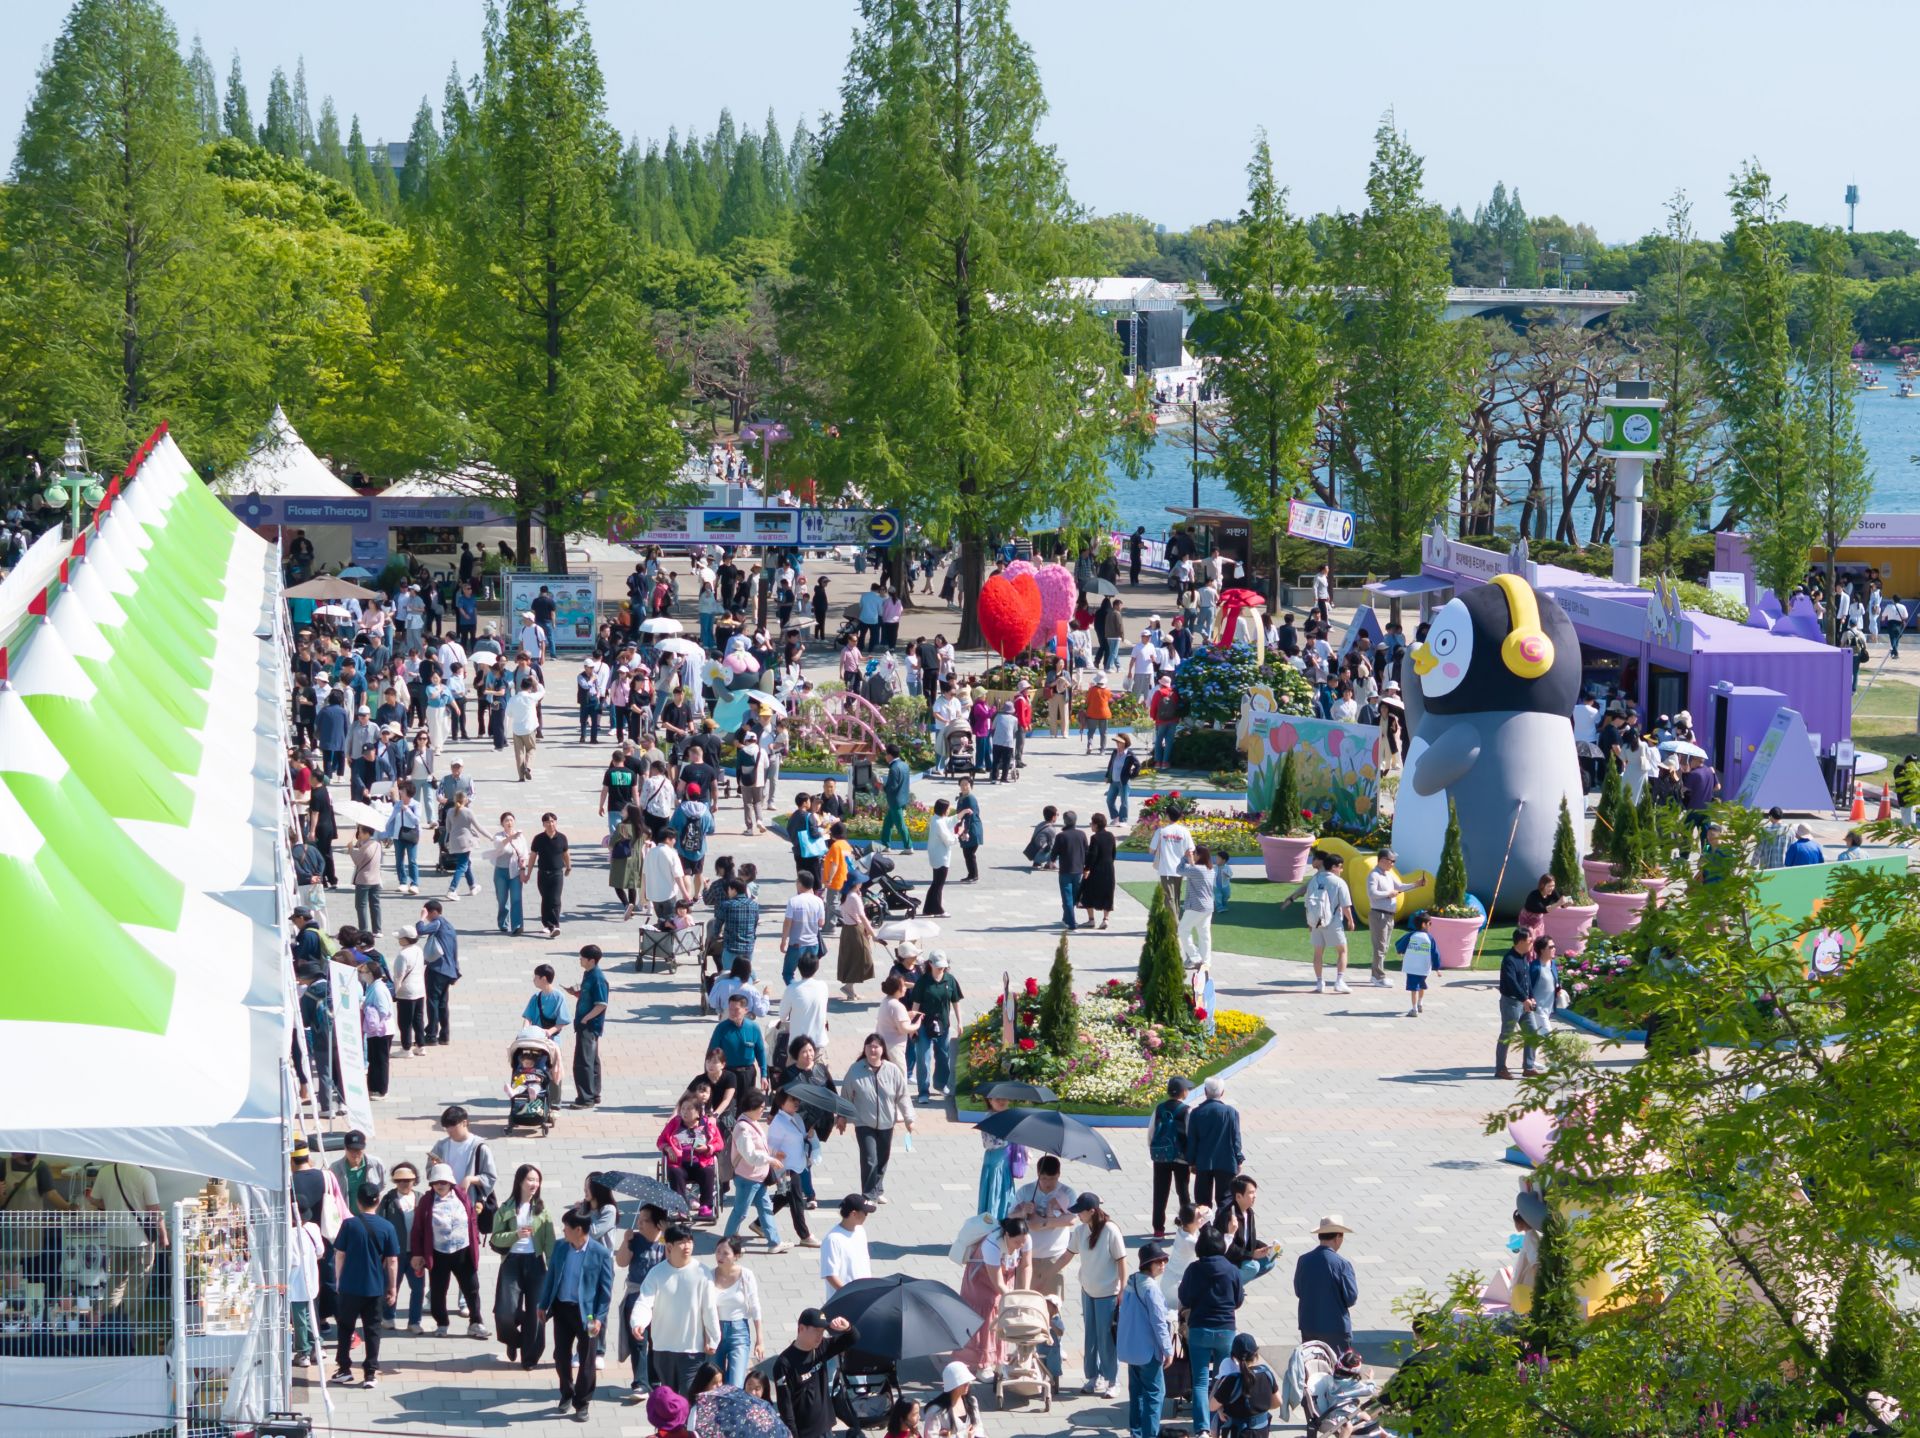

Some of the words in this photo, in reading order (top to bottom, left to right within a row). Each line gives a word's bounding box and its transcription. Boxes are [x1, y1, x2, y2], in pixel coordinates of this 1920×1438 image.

[288, 505, 321, 516] Flower
[323, 505, 368, 518] Therapy
[1858, 520, 1886, 530] Store
[1225, 527, 1248, 537] 자판기
